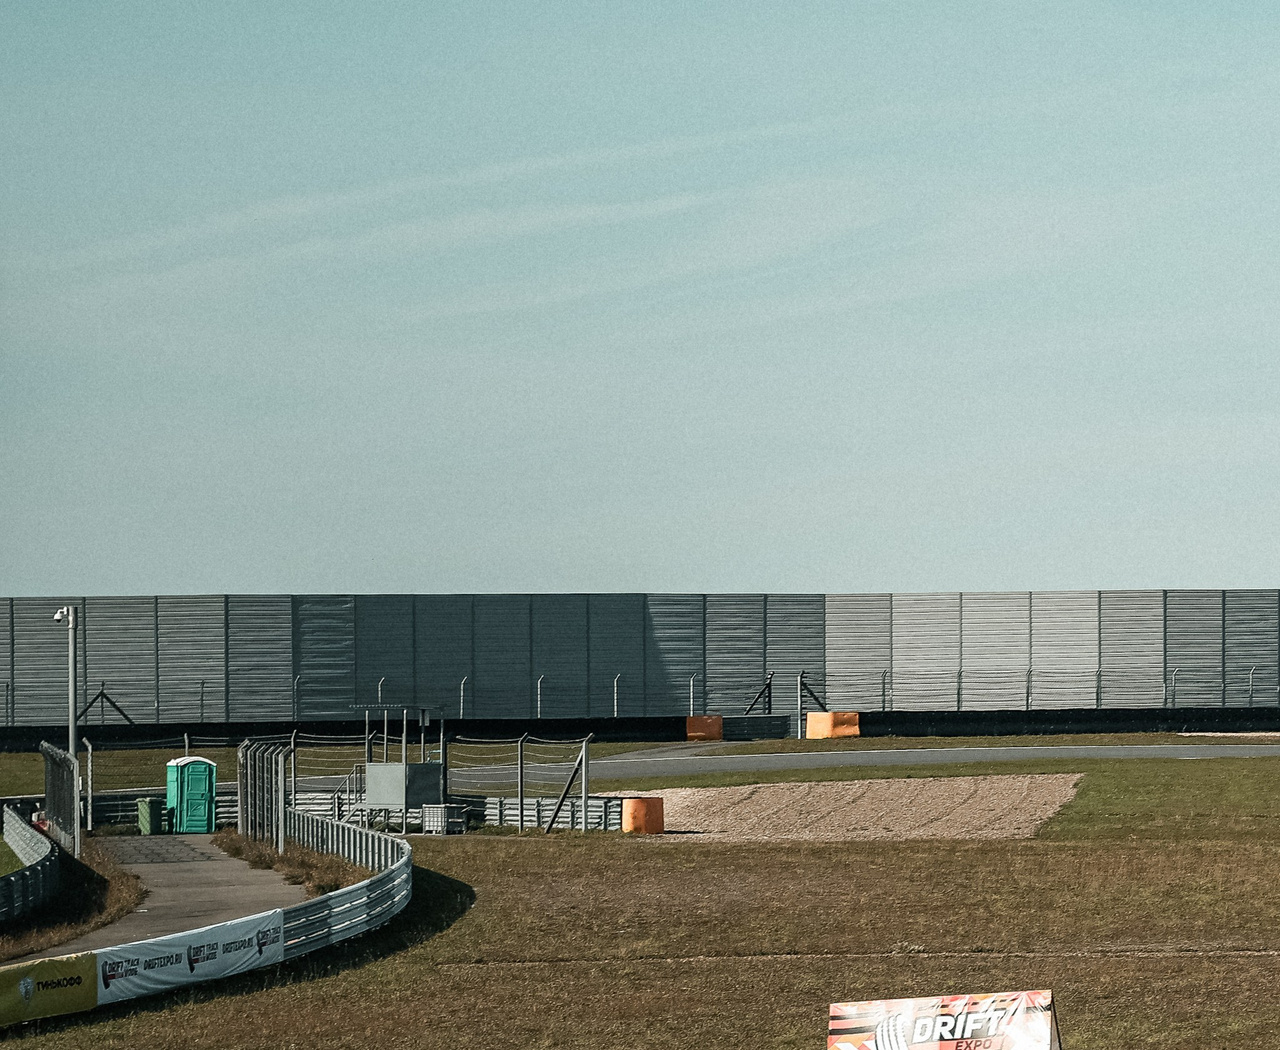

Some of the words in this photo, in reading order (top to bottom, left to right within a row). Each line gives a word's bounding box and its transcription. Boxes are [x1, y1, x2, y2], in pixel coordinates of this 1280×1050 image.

[192, 945, 206, 957] DRIFT
[108, 961, 124, 973] DRIFT
[143, 953, 183, 970] DRIFTEXPO.RU
[36, 976, 83, 991] ТИНЬКОФФ
[912, 1012, 1005, 1042] DRIFT
